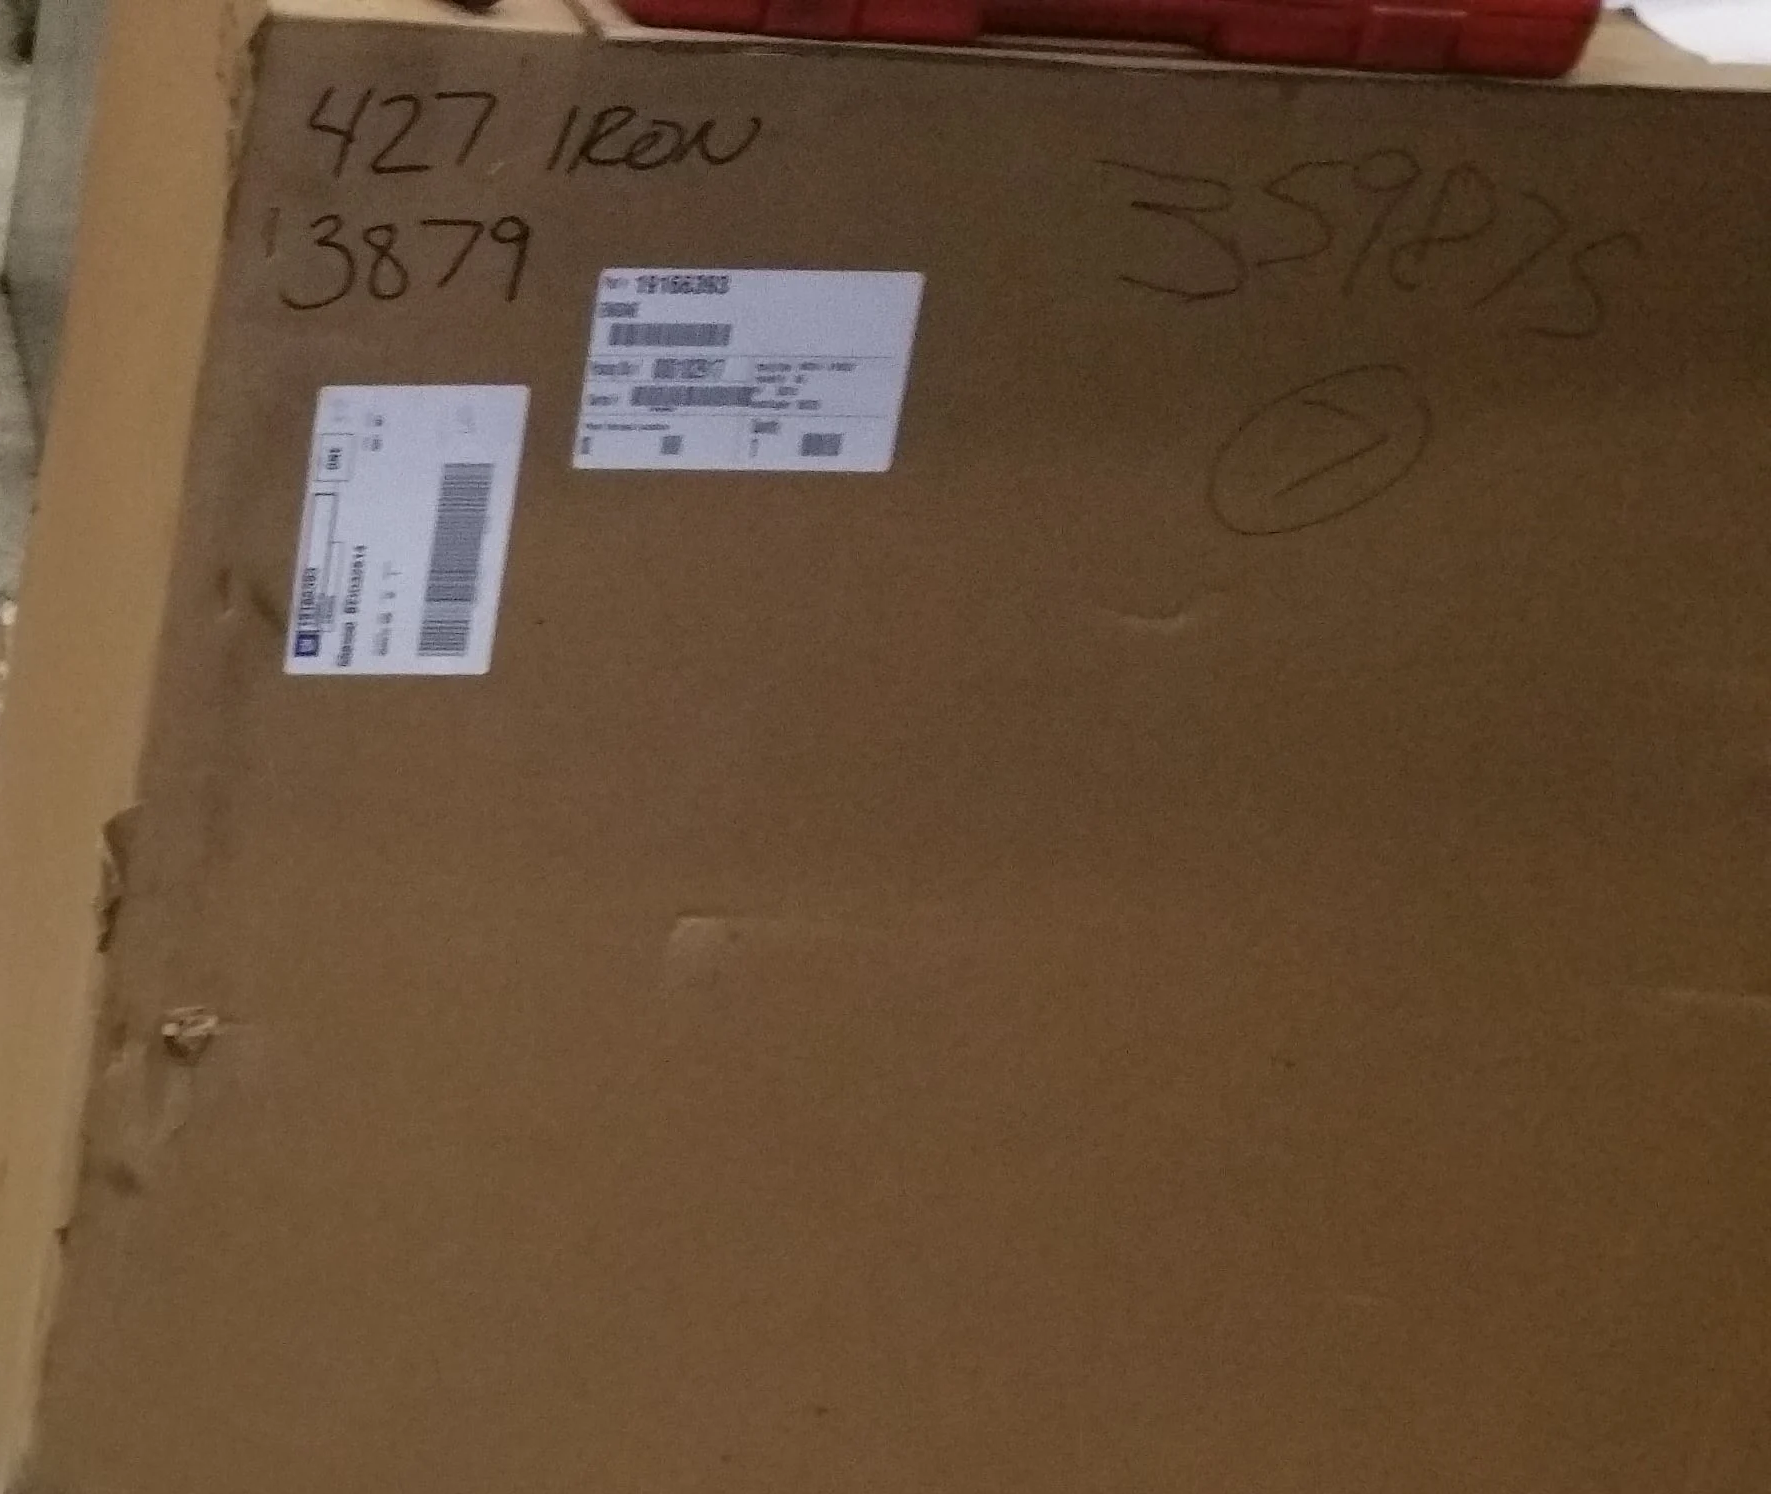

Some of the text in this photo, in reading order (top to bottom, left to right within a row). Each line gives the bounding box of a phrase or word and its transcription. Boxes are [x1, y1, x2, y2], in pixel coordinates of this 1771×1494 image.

[307, 86, 763, 178] 427 IRON
[278, 212, 533, 311] 3879
